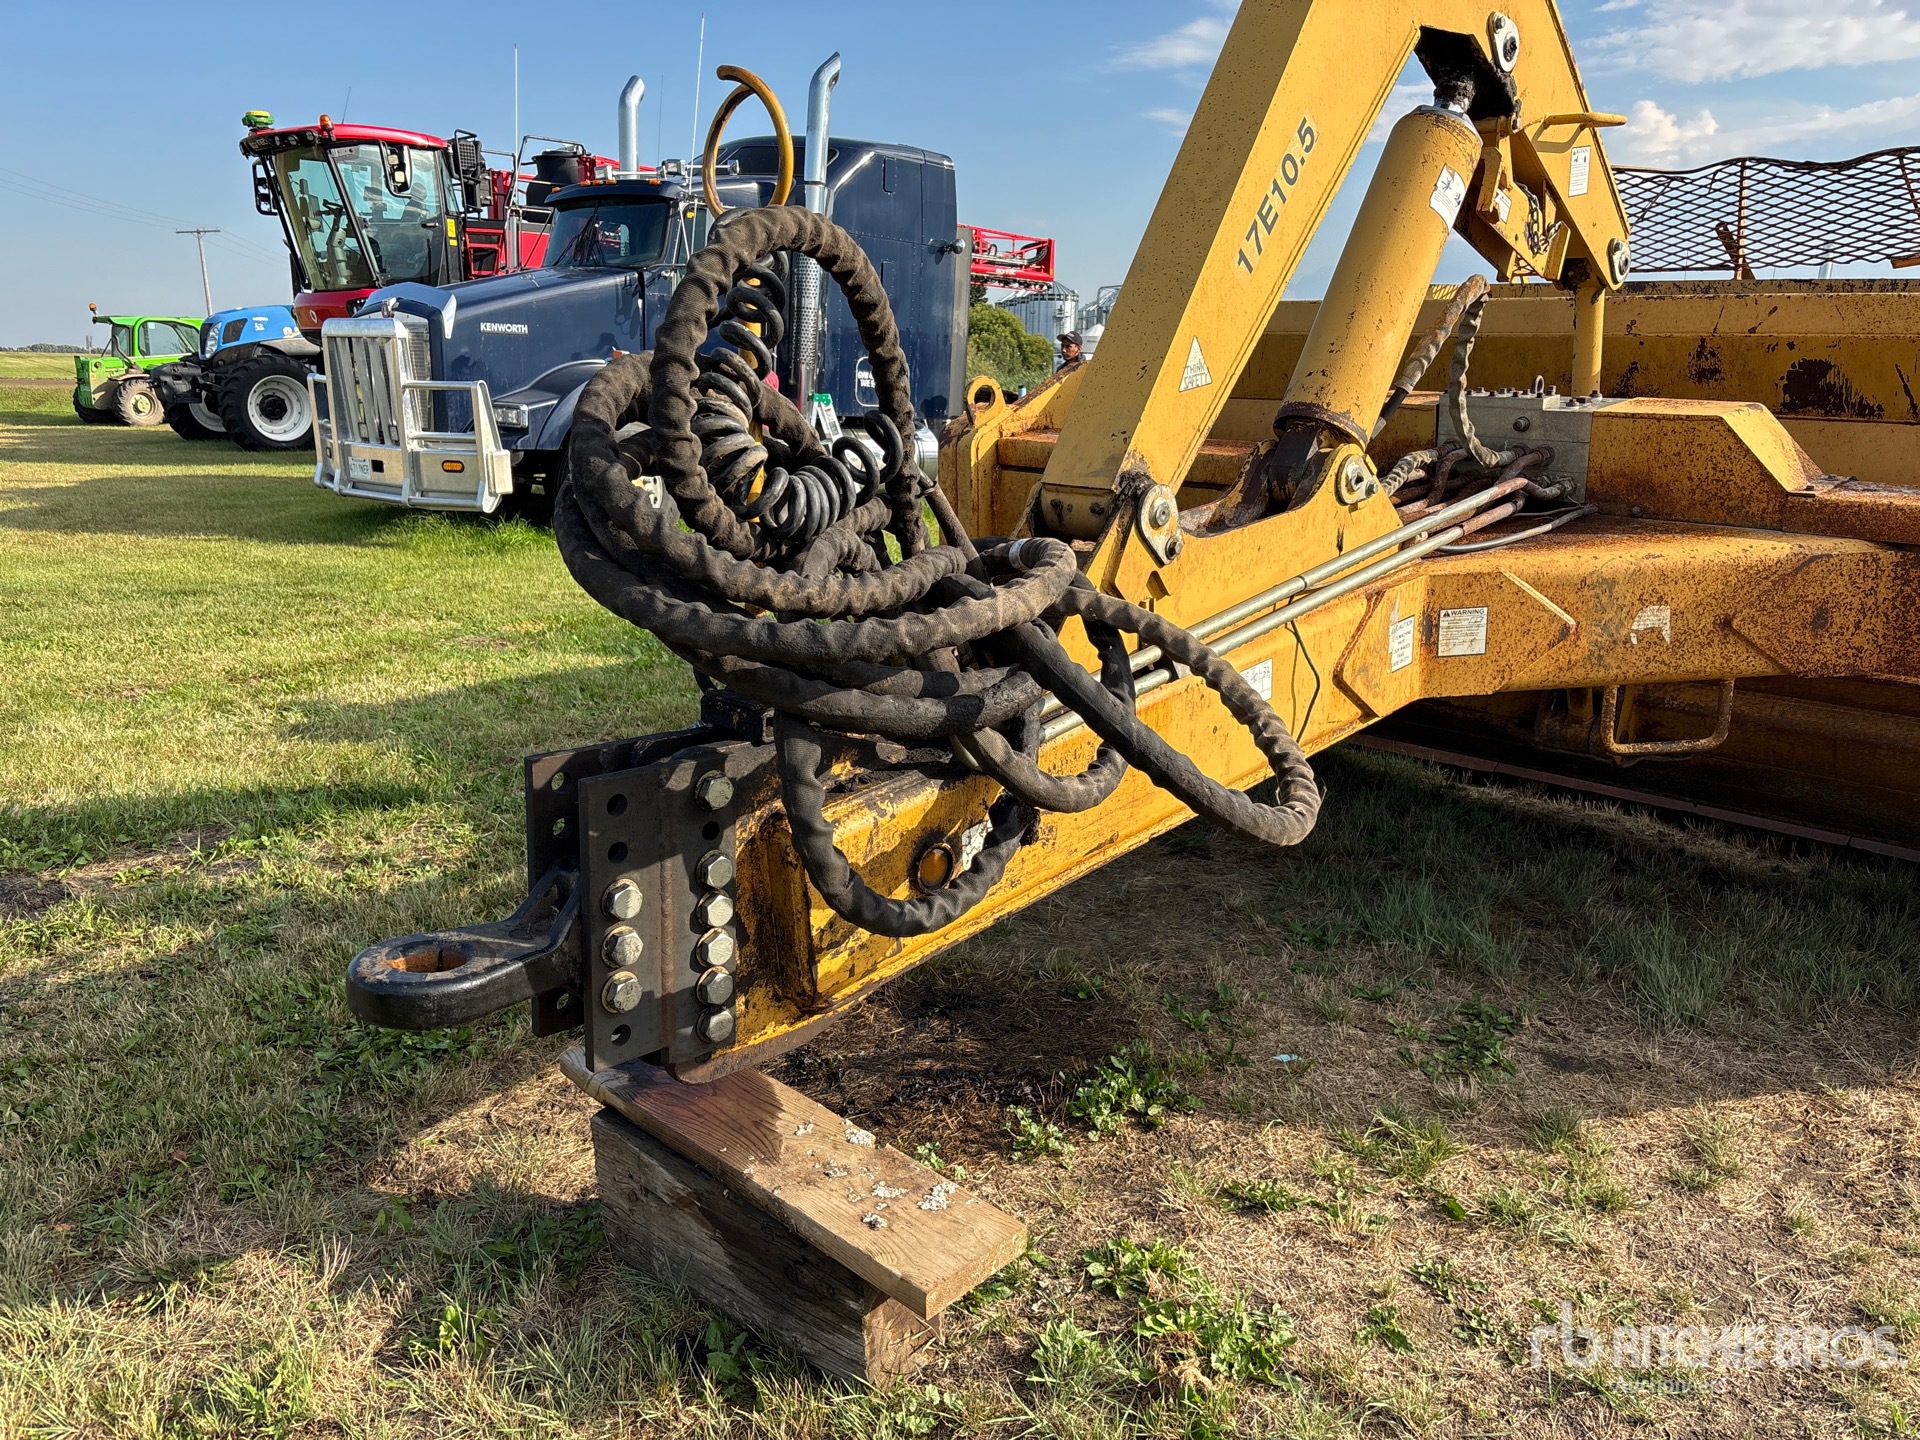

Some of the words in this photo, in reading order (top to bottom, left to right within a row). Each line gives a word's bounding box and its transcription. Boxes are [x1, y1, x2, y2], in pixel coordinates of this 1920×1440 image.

[1238, 117, 1315, 274] 17E10.5
[480, 322, 528, 334] KENWORTH
[1450, 608, 1485, 616] WARNING
